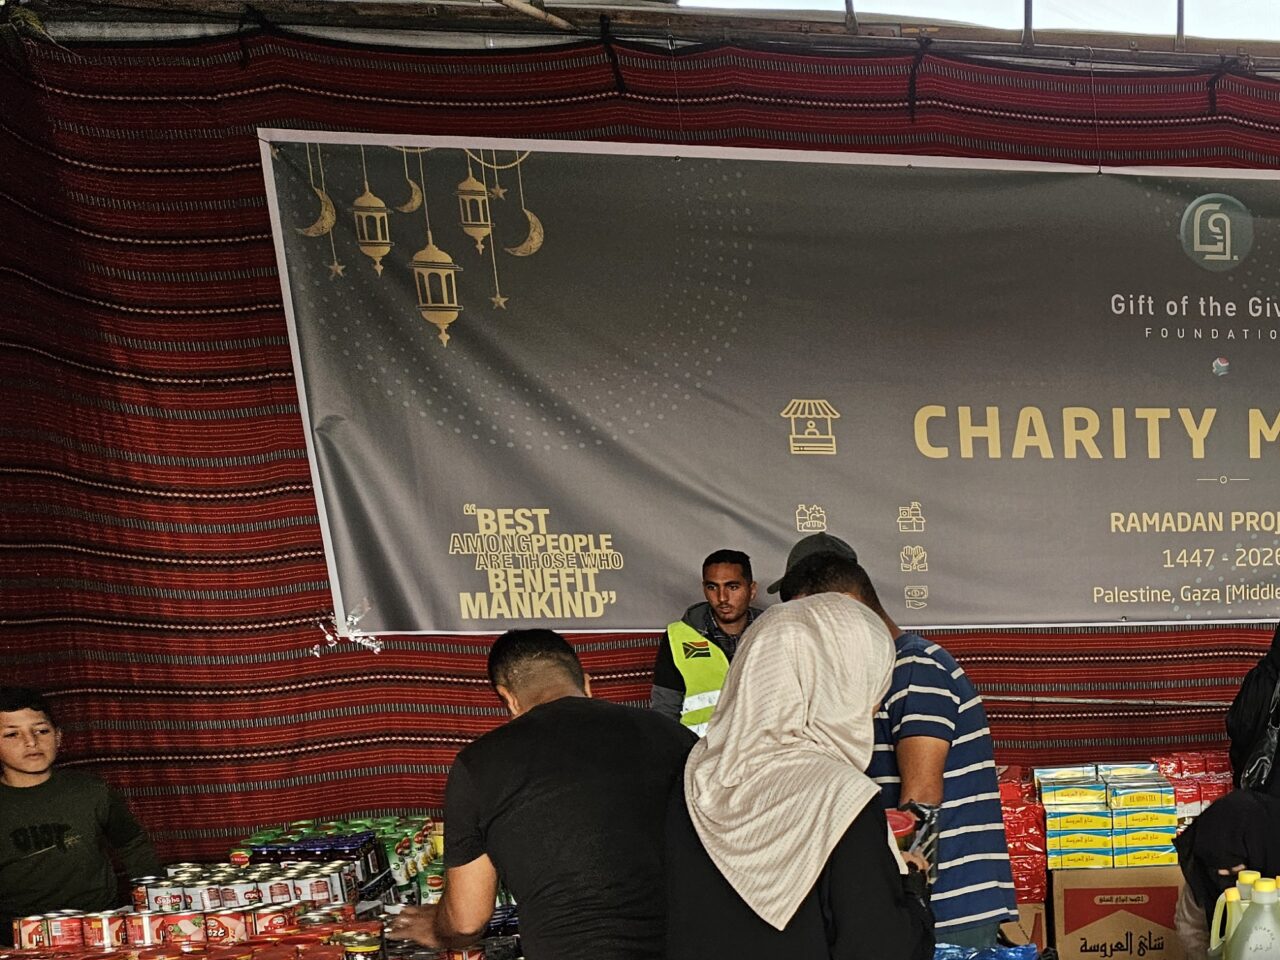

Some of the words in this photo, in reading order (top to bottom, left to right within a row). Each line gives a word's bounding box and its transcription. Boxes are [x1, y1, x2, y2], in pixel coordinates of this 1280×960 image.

[1111, 294, 1154, 315] Gift
[1166, 296, 1188, 316] of
[1199, 296, 1236, 317] the
[913, 405, 1217, 459] CHARITY
[1110, 512, 1223, 533] RAMADAN
[449, 533, 532, 554] AMONG
[531, 534, 613, 554] PEOPLE
[475, 552, 513, 570] ARE
[518, 552, 576, 569] THOSE
[579, 551, 624, 570] WHO
[1162, 549, 1214, 568] 1447
[488, 568, 599, 593] BENEFIT
[1093, 587, 1175, 604] Palestine,
[1180, 586, 1220, 602] Gaza
[1080, 932, 1133, 957] العروسة
